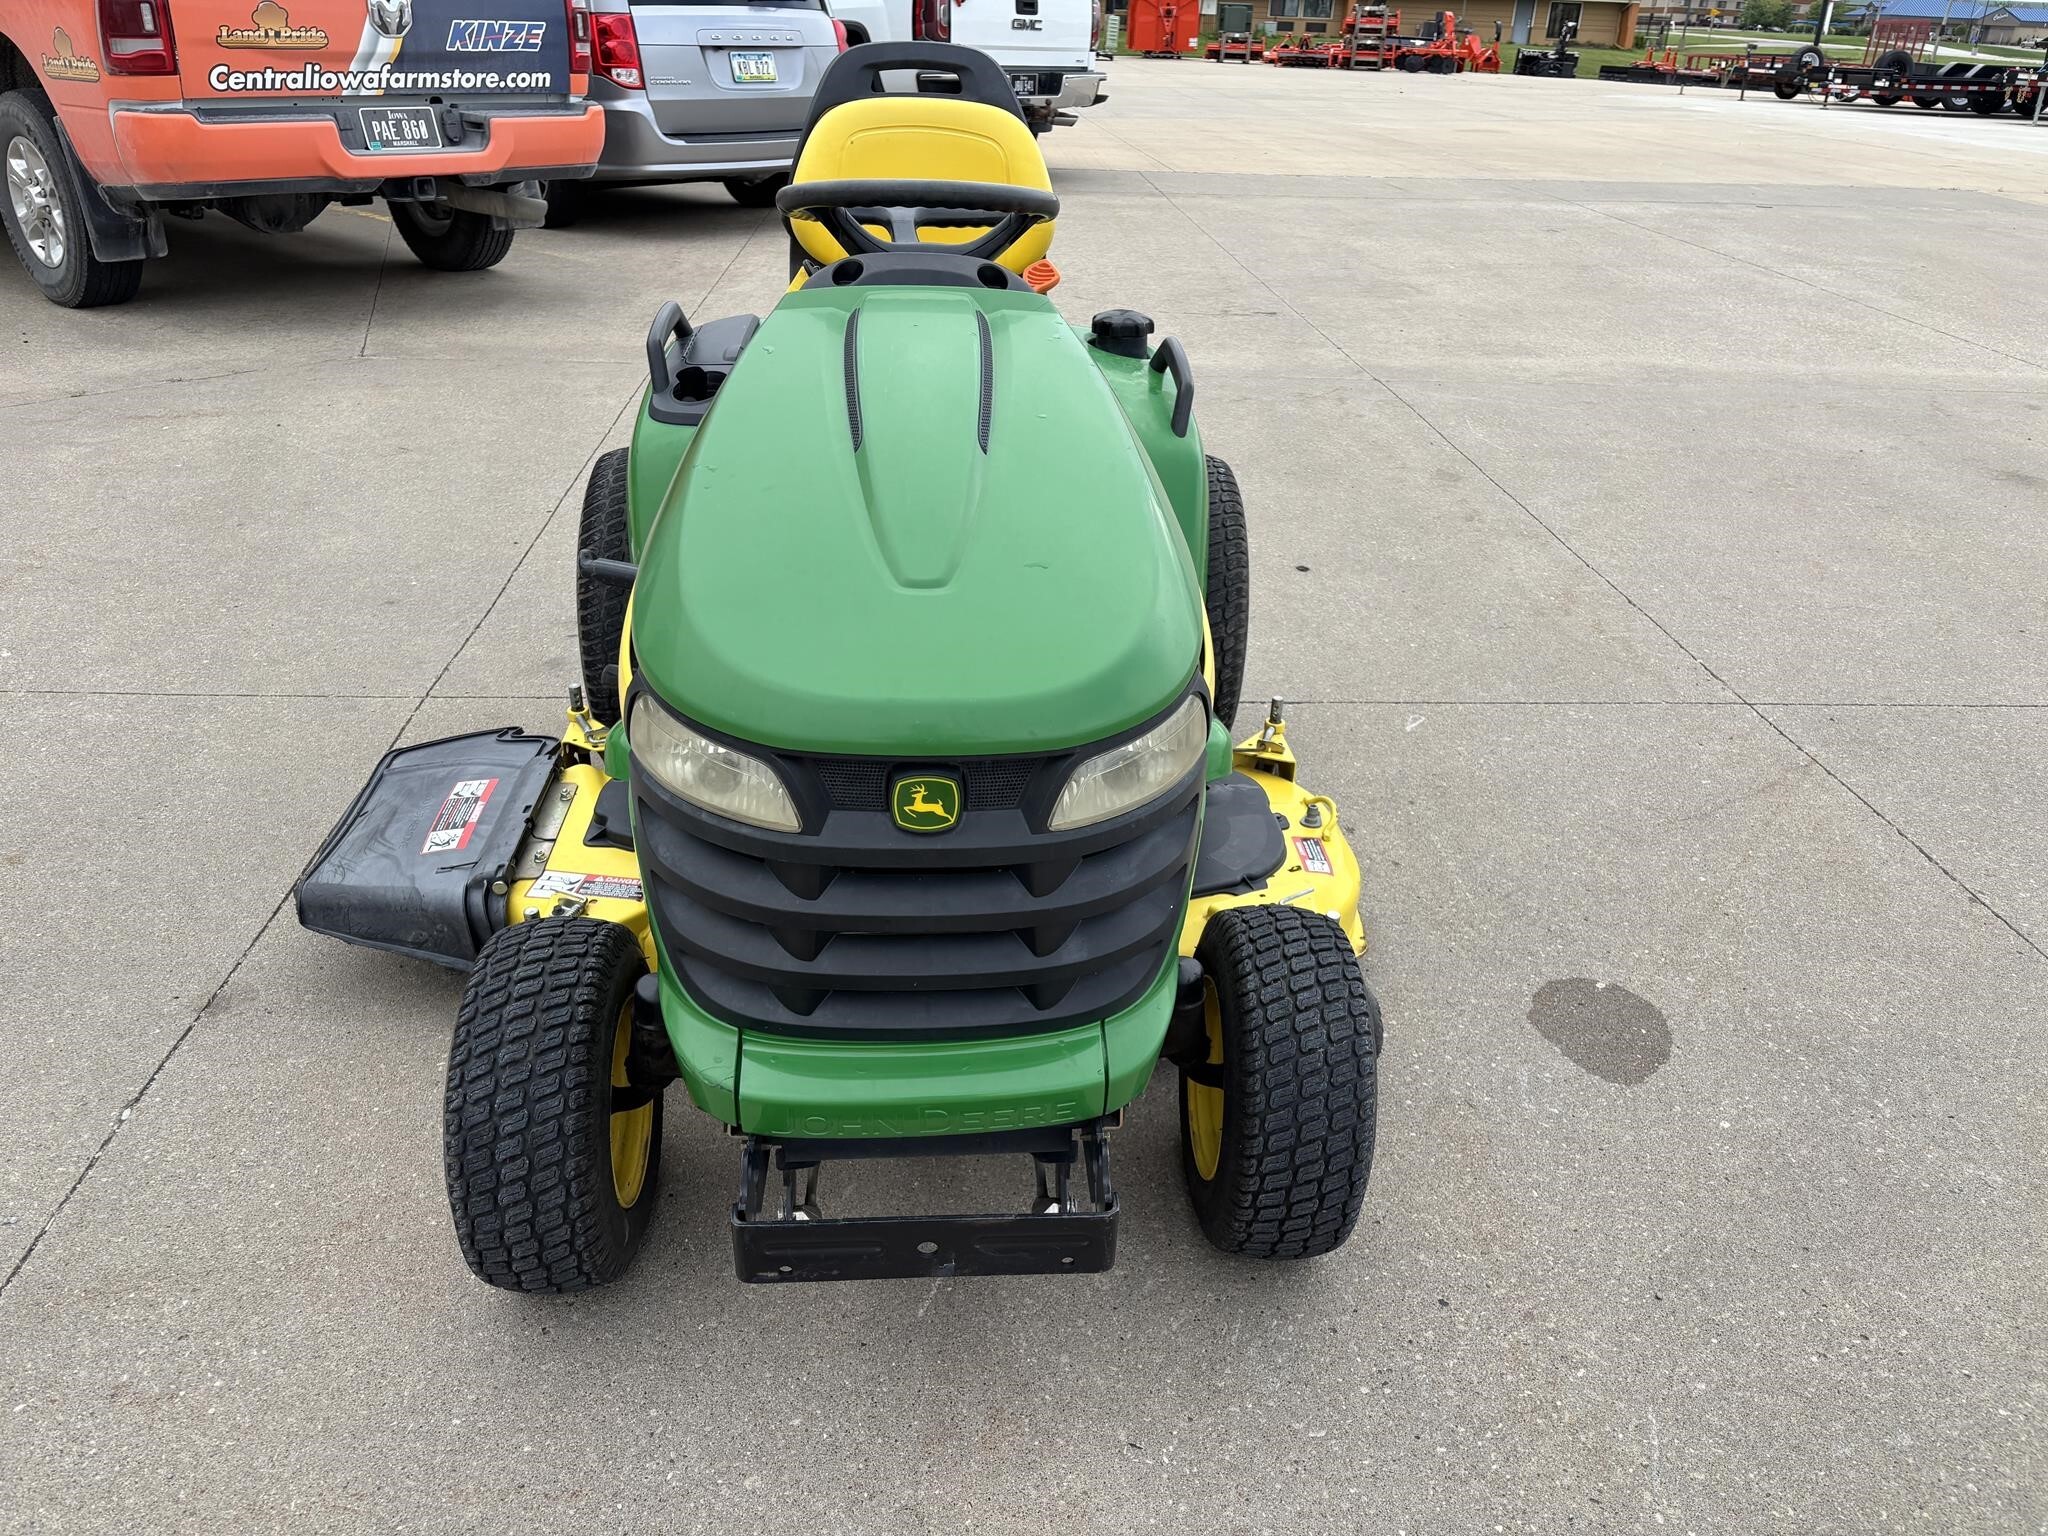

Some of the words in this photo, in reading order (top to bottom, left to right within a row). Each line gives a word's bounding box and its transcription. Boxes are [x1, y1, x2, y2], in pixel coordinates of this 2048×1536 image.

[219, 26, 266, 42] Land
[279, 27, 326, 42] Pride
[446, 20, 546, 51] KINZE
[1012, 19, 1042, 31] GMC
[209, 63, 551, 91] Centraliowafarmstore.com
[371, 120, 400, 141] PAE
[402, 119, 429, 140] 860
[771, 1107, 904, 1136] JOHN
[919, 1101, 1077, 1133] DEERE
